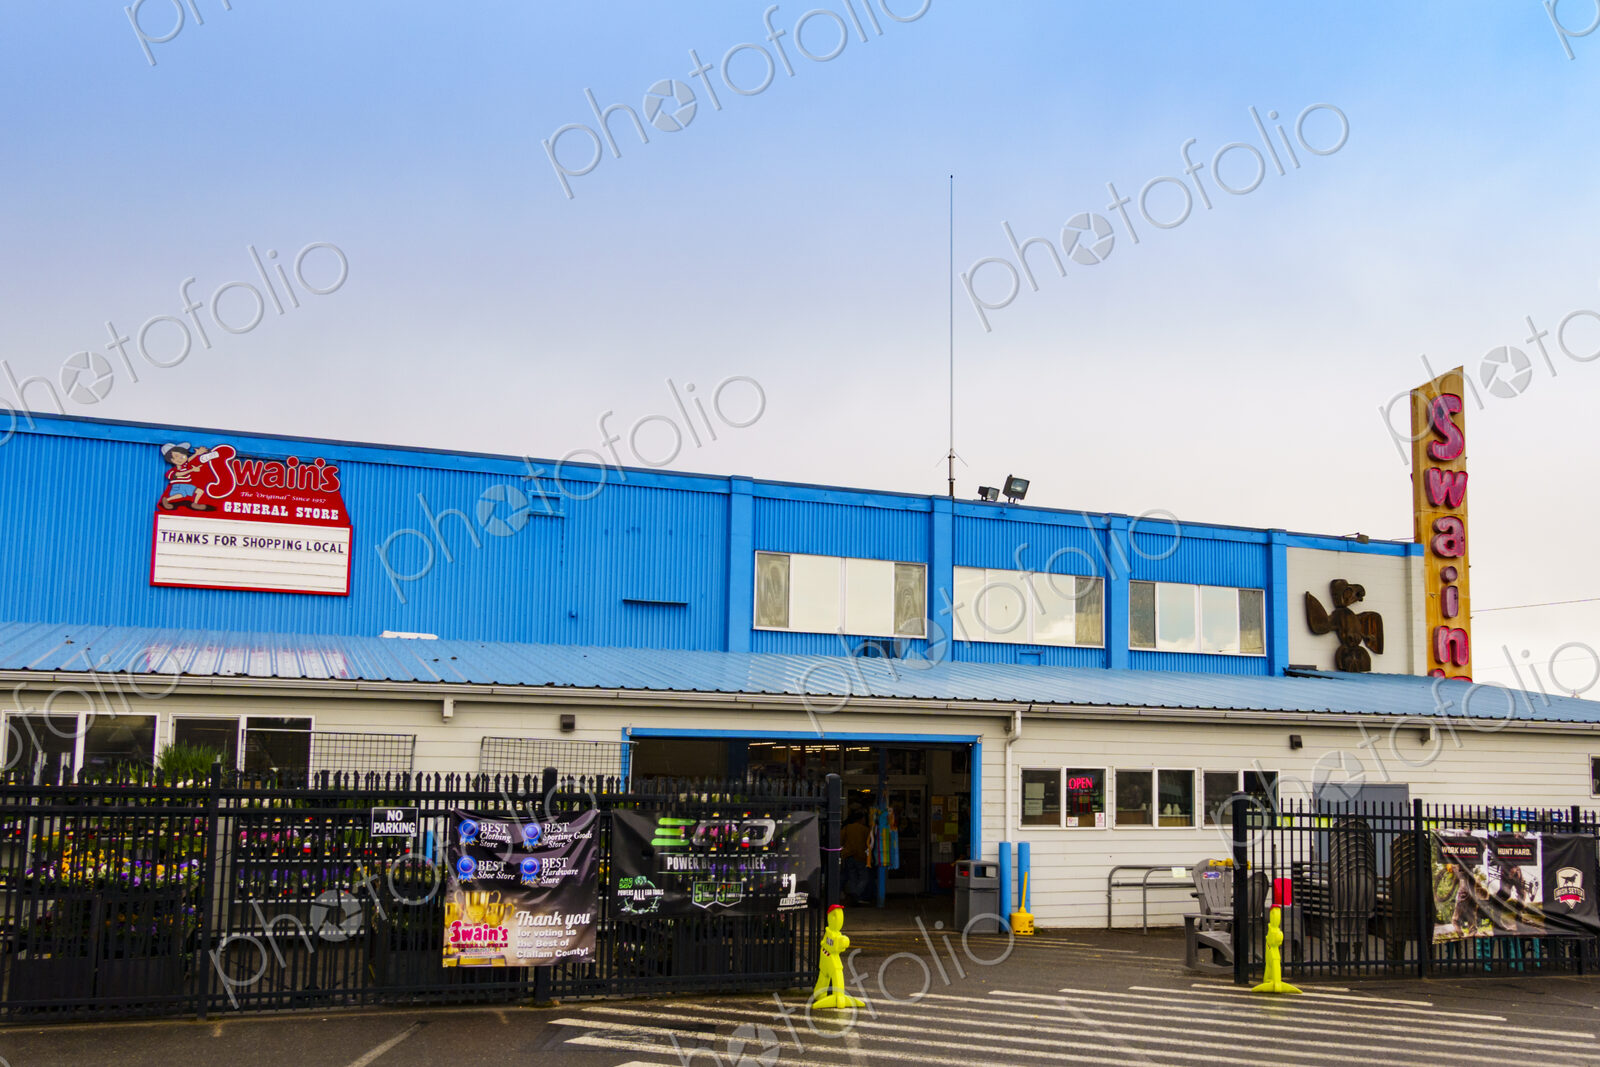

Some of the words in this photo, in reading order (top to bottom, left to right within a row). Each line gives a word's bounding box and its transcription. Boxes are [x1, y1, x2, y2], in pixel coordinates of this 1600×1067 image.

[205, 444, 341, 499] Swain's
[224, 501, 289, 518] GENERAL
[296, 507, 339, 521] STORE
[161, 531, 209, 545] THANKS
[214, 535, 237, 546] FOR
[242, 536, 302, 550] SHOPPING
[306, 541, 344, 554] LOCAL
[1068, 777, 1093, 790] OPEN
[387, 810, 403, 821] NO
[373, 822, 416, 834] PARKING
[480, 822, 508, 833] BEST
[544, 822, 570, 833] BEST
[480, 832, 512, 843] Clothing
[480, 840, 498, 848] Store
[1442, 846, 1459, 854] WORK
[1460, 847, 1478, 855] HARD.
[1514, 848, 1532, 856] HARD.
[478, 860, 507, 872] BEST
[542, 857, 569, 868] BEST
[666, 856, 699, 870] POWER
[478, 870, 495, 880] Shoe
[496, 870, 516, 880] Store
[541, 876, 560, 884] Store
[782, 873, 796, 898] #1
[634, 889, 646, 900] ALL
[694, 884, 702, 902] 5
[515, 910, 562, 926] Thank
[564, 912, 591, 930] you
[450, 920, 508, 943] Swain's
[518, 928, 530, 937] for
[534, 928, 564, 938] voting
[565, 928, 577, 936] us
[516, 939, 532, 948] the
[534, 938, 558, 948] Best
[560, 938, 570, 947] of
[516, 950, 553, 958] Clallam
[554, 946, 590, 958] County!
